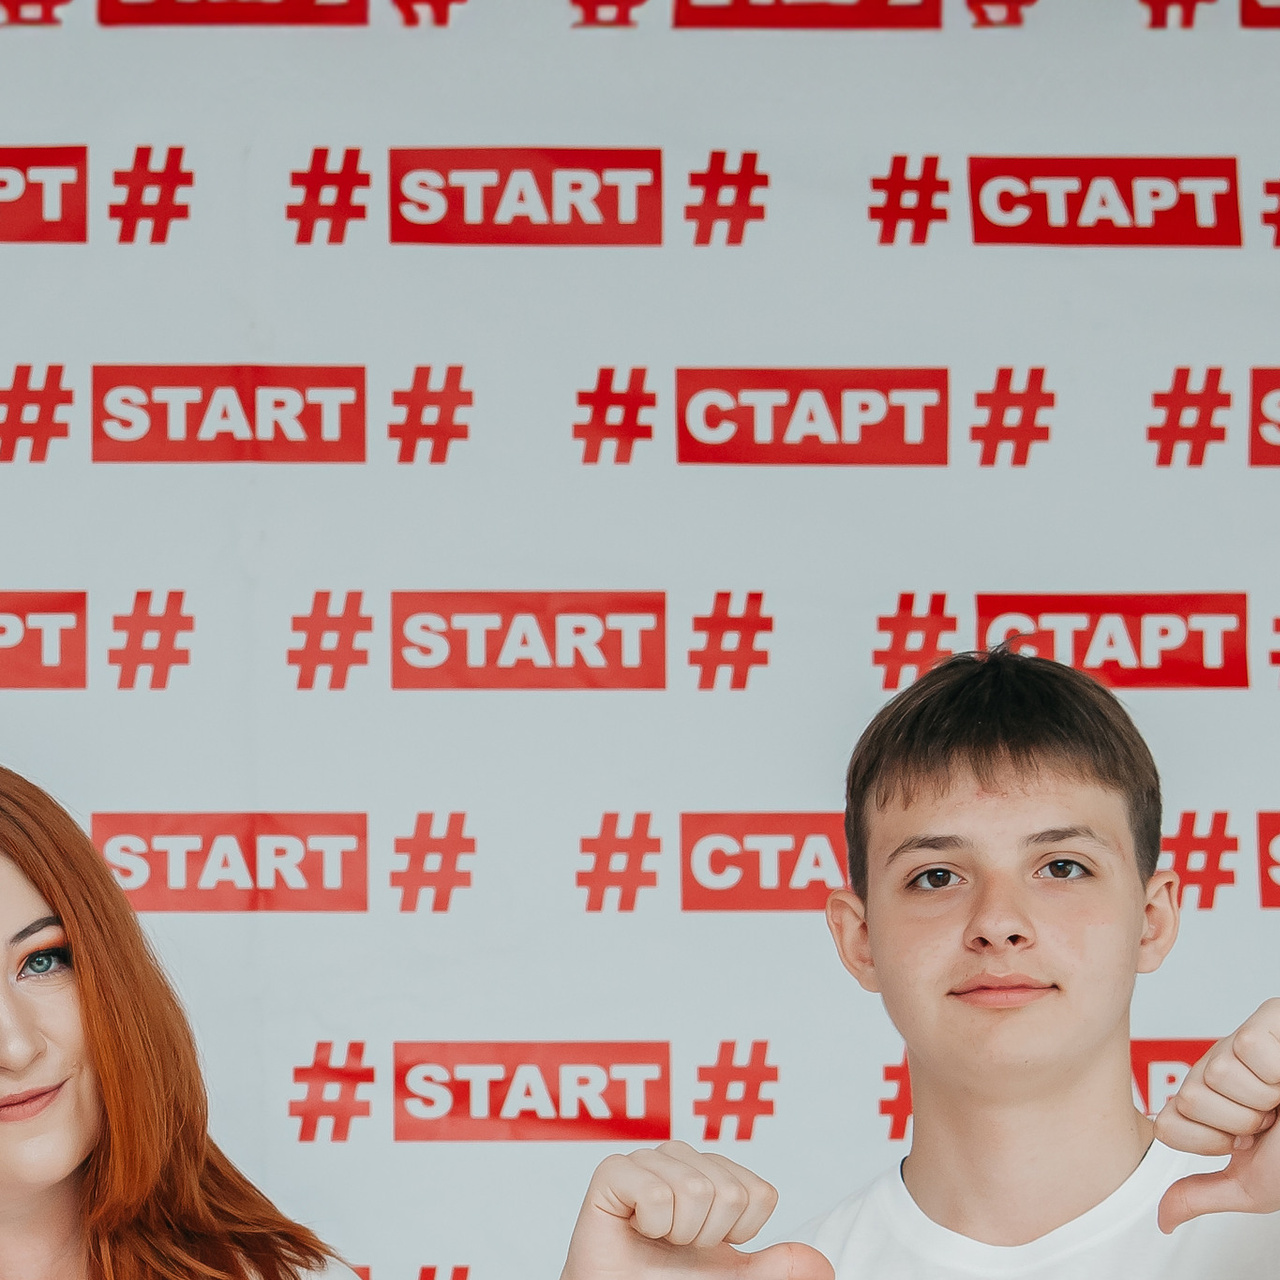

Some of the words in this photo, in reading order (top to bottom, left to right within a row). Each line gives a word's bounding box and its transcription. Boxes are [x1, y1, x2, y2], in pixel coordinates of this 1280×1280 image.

[399, 169, 653, 225] START
[979, 176, 1229, 228] СТАРТ
[102, 386, 357, 442] START
[685, 389, 940, 444] СТАРТ
[401, 612, 657, 669] START
[102, 833, 359, 891] START
[690, 833, 846, 890] СТА
[403, 1062, 662, 1121] START
